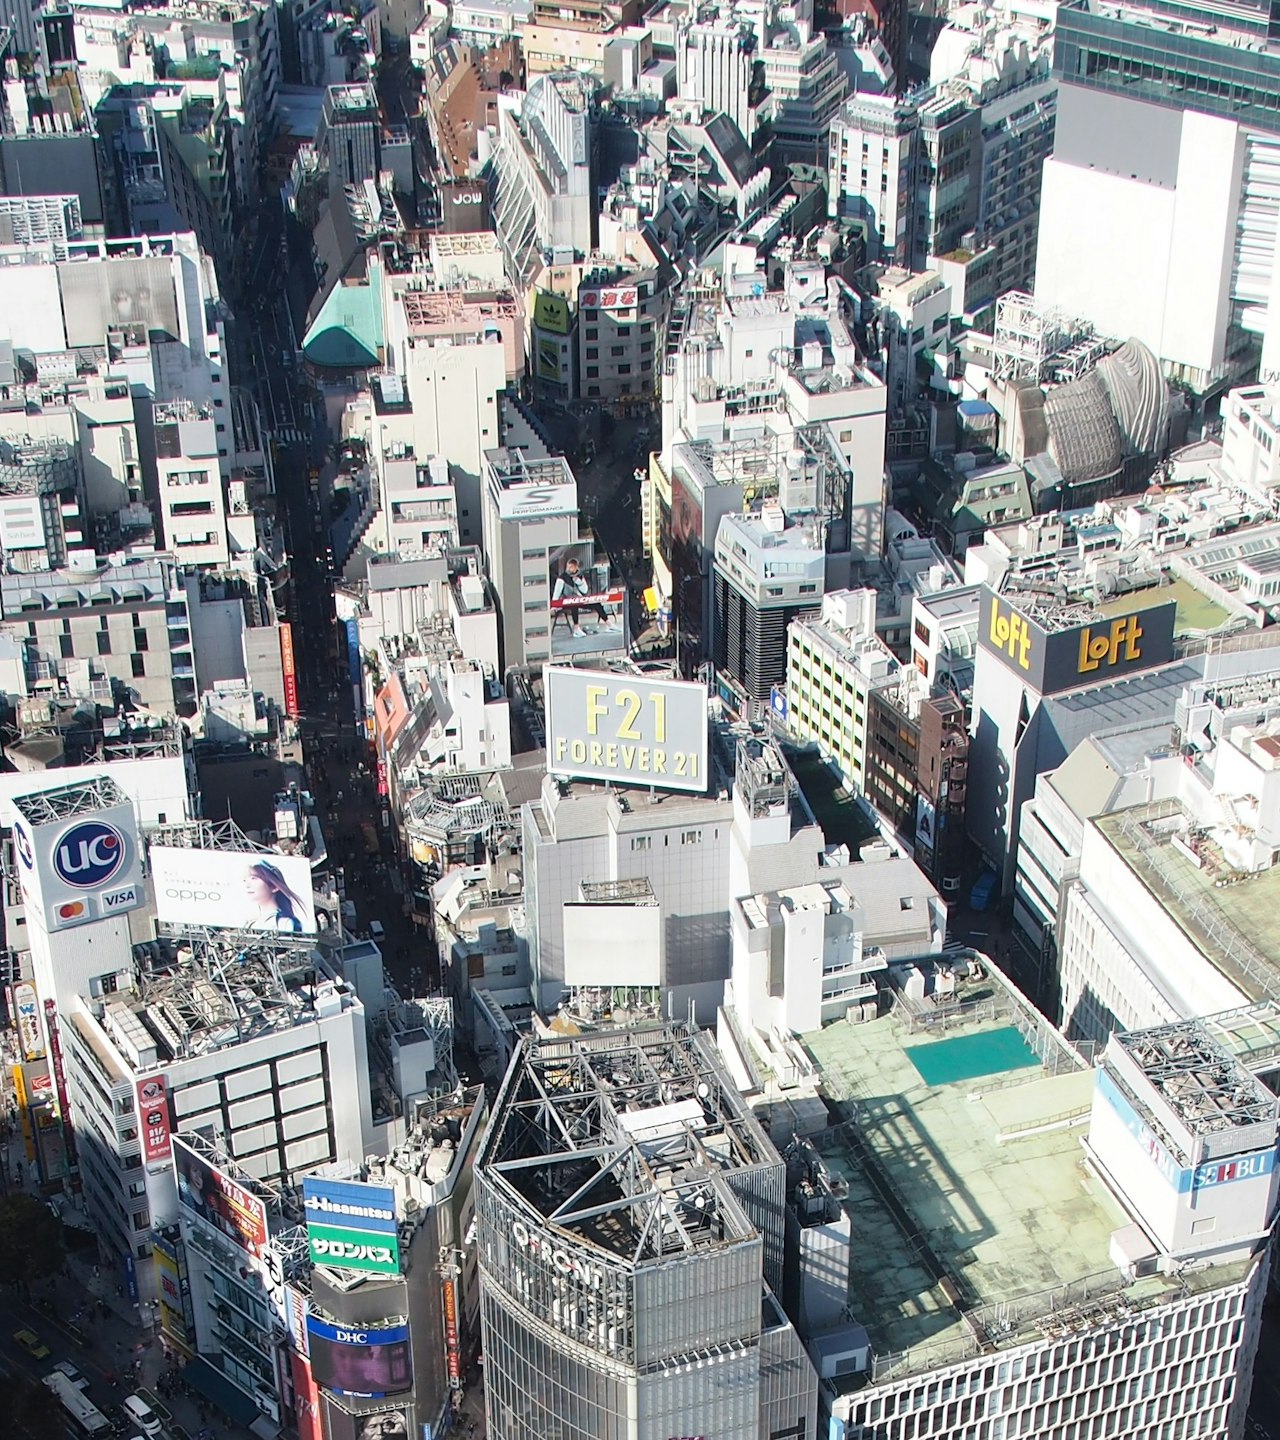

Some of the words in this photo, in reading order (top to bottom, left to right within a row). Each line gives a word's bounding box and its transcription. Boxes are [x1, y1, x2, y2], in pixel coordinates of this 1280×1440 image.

[453, 191, 482, 205] JOW
[562, 594, 610, 605] SKECHERS
[586, 683, 668, 743] F21
[554, 736, 668, 776] FOREVER
[672, 749, 700, 779] 21
[59, 835, 120, 872] UC
[105, 889, 135, 907] VISA
[165, 886, 221, 905] oppo
[1194, 1154, 1266, 1190] SEIBU
[306, 1196, 392, 1220] Hisamitsu
[311, 1237, 394, 1264] サロンパス
[511, 1221, 603, 1290] QFRONT
[336, 1330, 368, 1344] DHC
